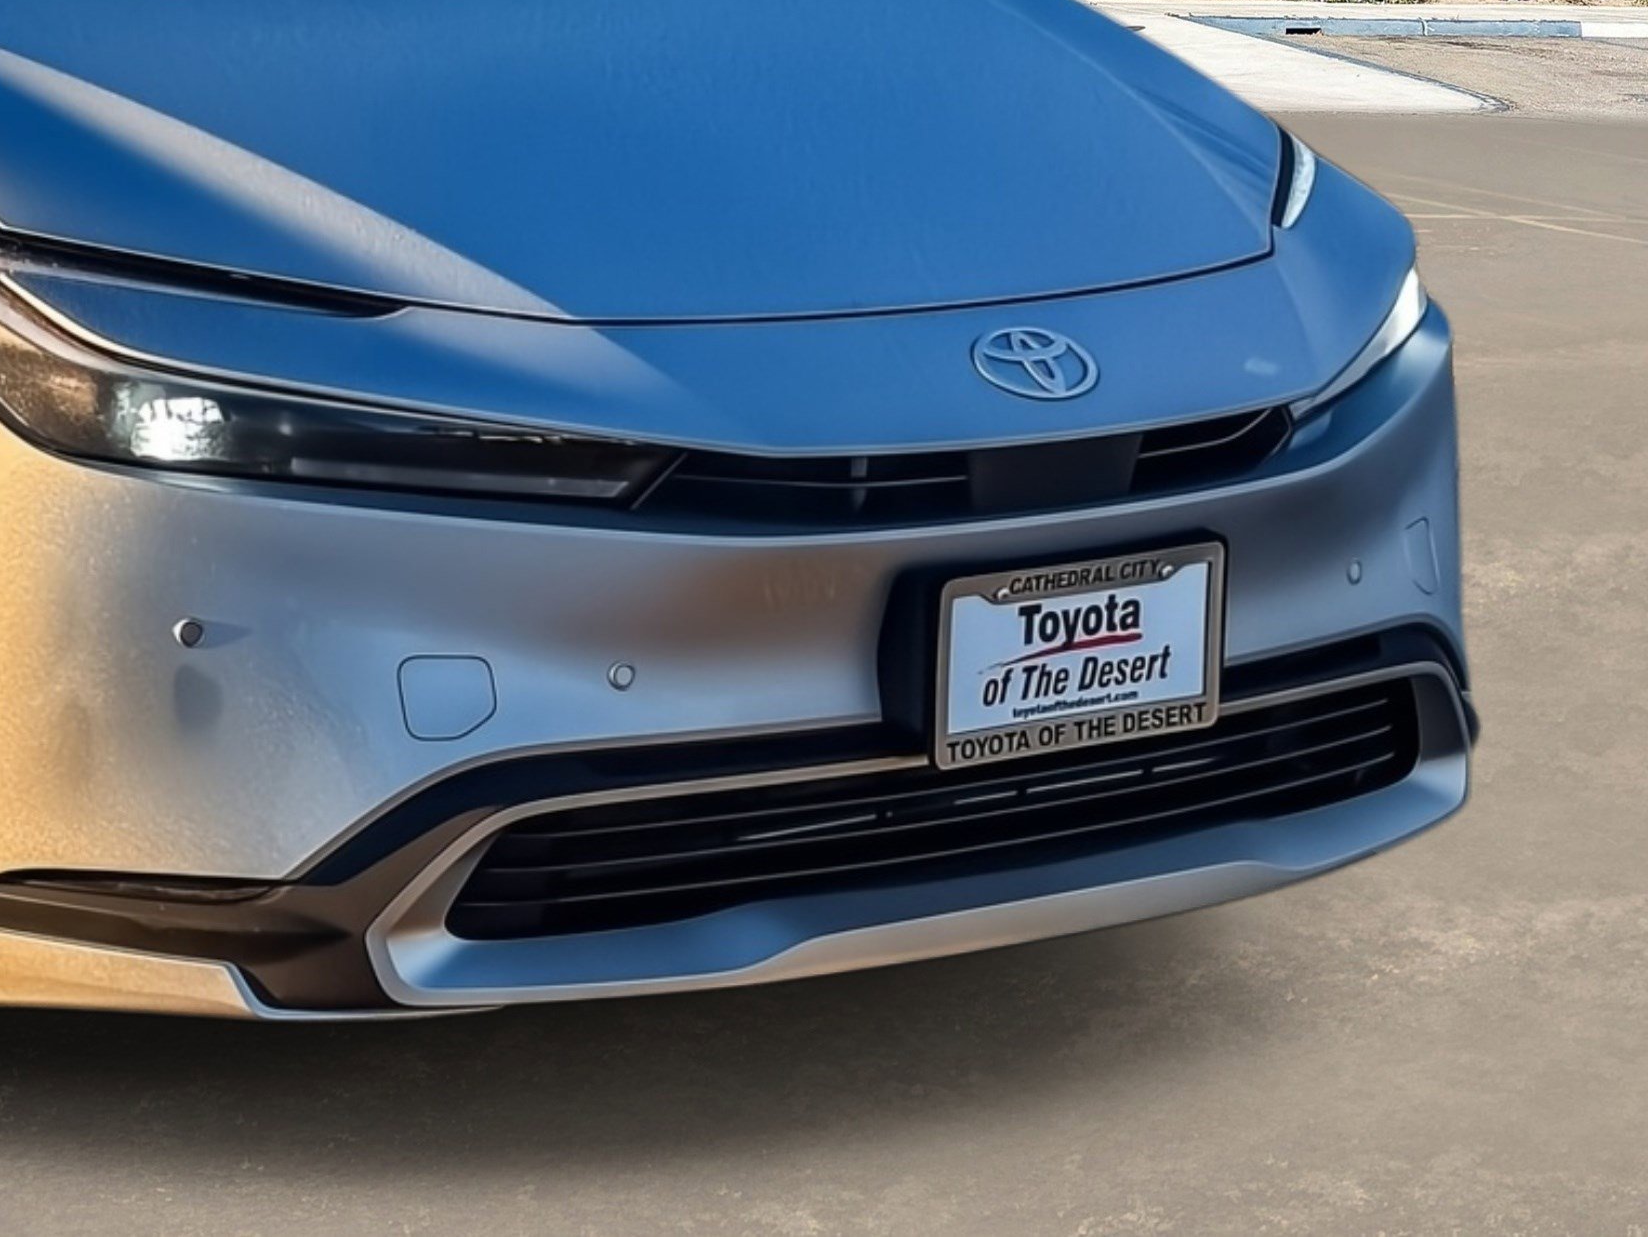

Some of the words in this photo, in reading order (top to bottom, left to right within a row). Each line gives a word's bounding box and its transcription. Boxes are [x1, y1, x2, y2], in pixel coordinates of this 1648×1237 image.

[1008, 565, 1116, 595] CATHEDRAL
[1119, 559, 1162, 580] CITY
[1018, 593, 1141, 646] Toyota
[982, 666, 1014, 708] of
[1020, 662, 1071, 701] The
[1077, 644, 1172, 692] Desert
[946, 730, 1031, 763] TOYOTA
[1038, 723, 1068, 747] OF
[1073, 716, 1117, 742] THE
[1122, 702, 1207, 733] DESERT
